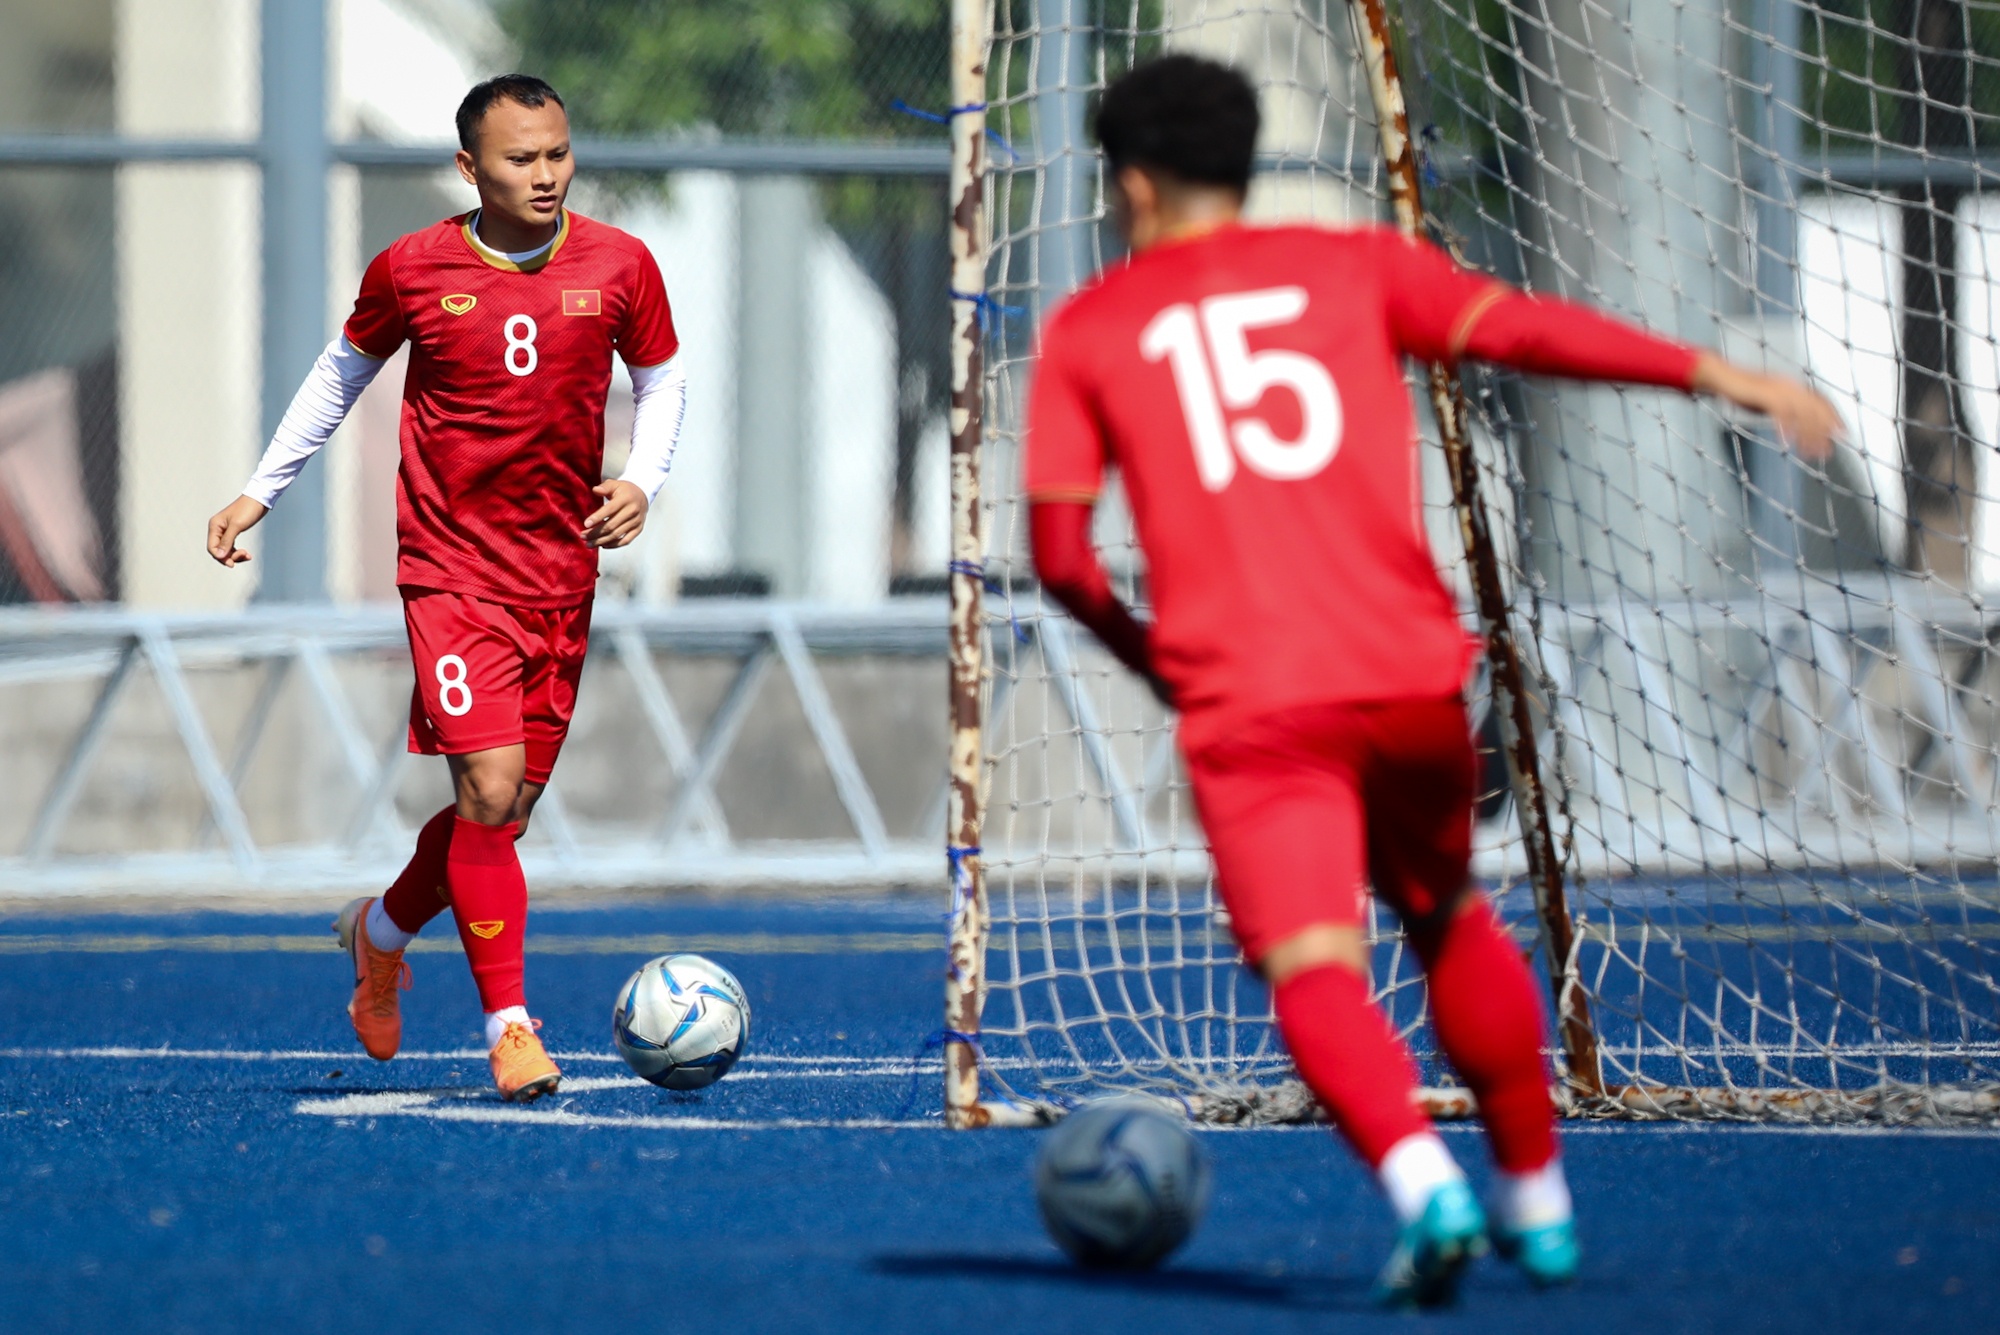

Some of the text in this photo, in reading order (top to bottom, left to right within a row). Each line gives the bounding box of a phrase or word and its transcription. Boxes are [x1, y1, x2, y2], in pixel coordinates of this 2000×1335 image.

[503, 313, 538, 377] 8
[1140, 286, 1344, 492] 15
[435, 653, 473, 717] 8
